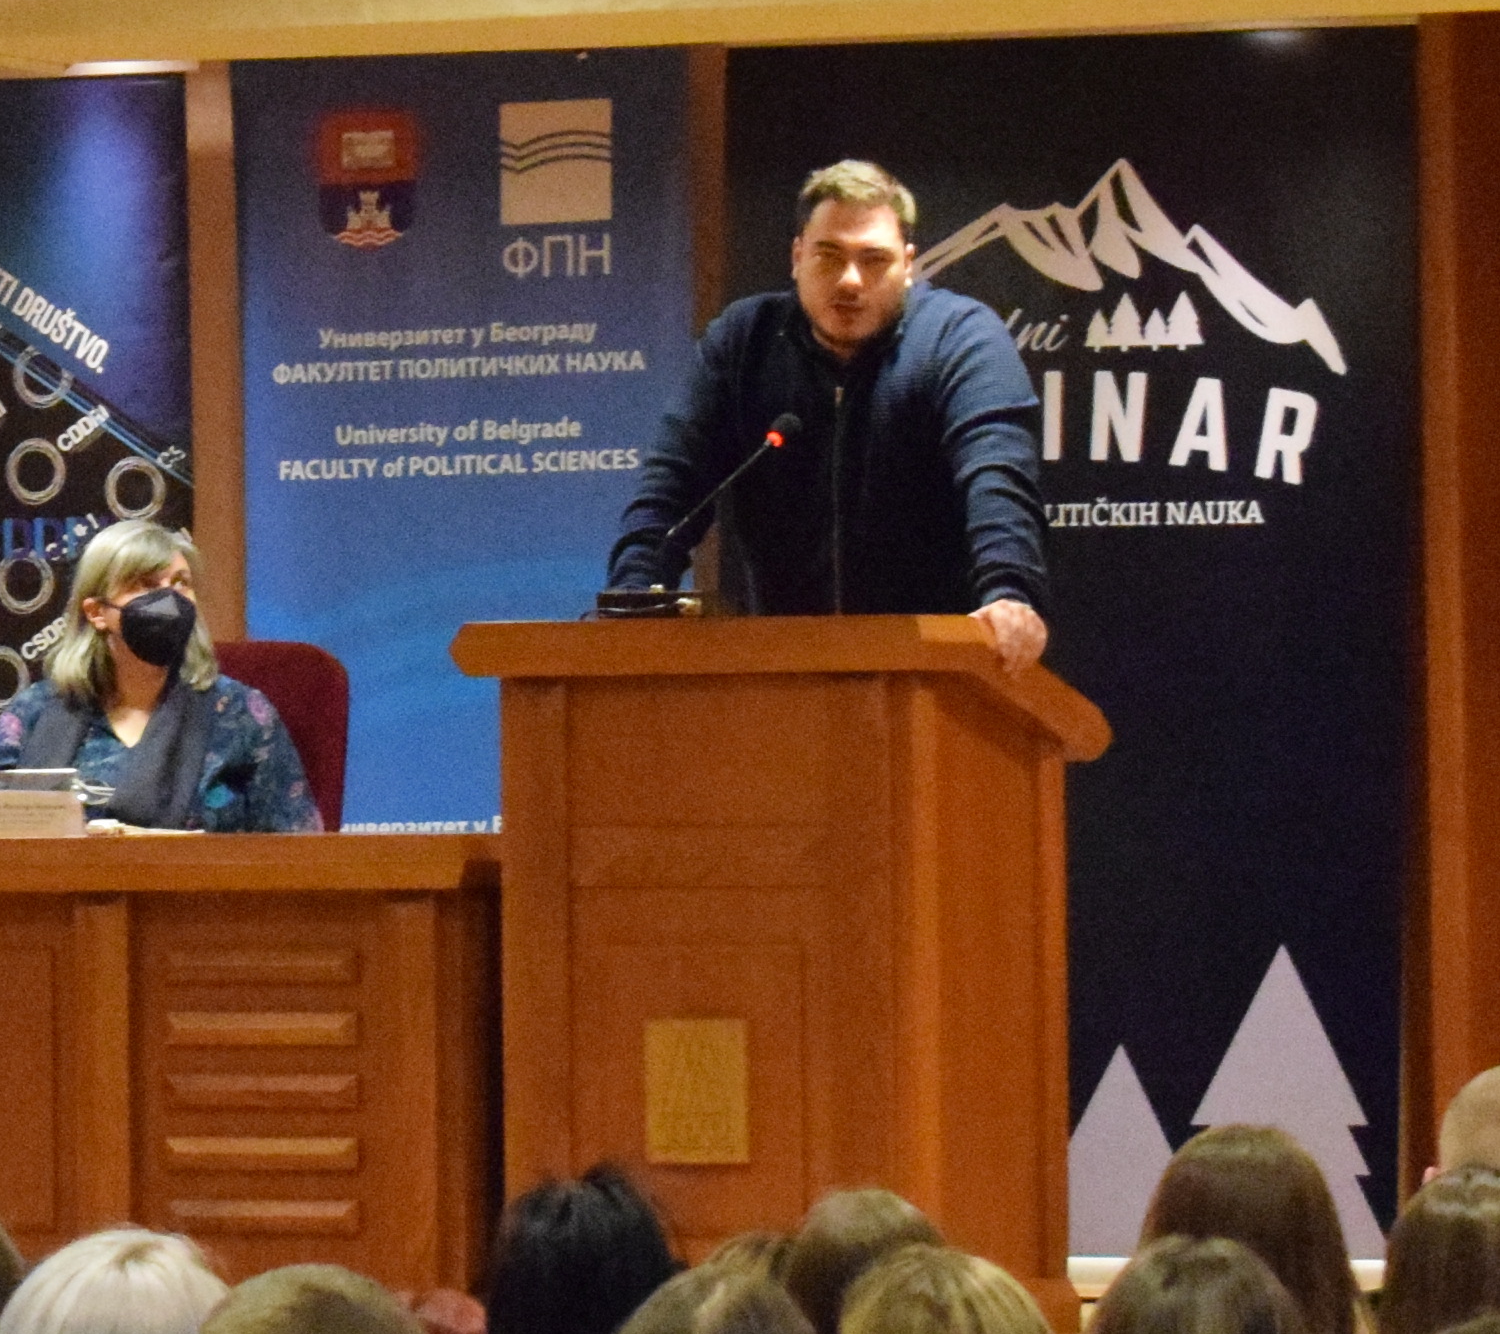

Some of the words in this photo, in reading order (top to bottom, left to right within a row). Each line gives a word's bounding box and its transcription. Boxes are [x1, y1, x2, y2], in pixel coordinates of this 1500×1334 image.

[502, 233, 612, 278] ФПН
[11, 286, 110, 373] DRUŠTVO.
[319, 327, 464, 350] Универзитет
[471, 328, 485, 347] у
[490, 321, 597, 344] Београду
[272, 359, 393, 385] ФАКУЛТЕТ
[400, 353, 560, 380] ПОЛИТИЧКИХ
[566, 350, 646, 373] НАУКА
[335, 421, 448, 447] University
[453, 419, 478, 441] of
[483, 416, 582, 442] Belgrade
[279, 458, 378, 481] FACULTY
[382, 456, 402, 478] of
[409, 453, 527, 477] POLITICAL
[532, 449, 640, 472] SCIENCES
[1164, 500, 1265, 524] NAUKA
[21, 616, 67, 660] CSDR
